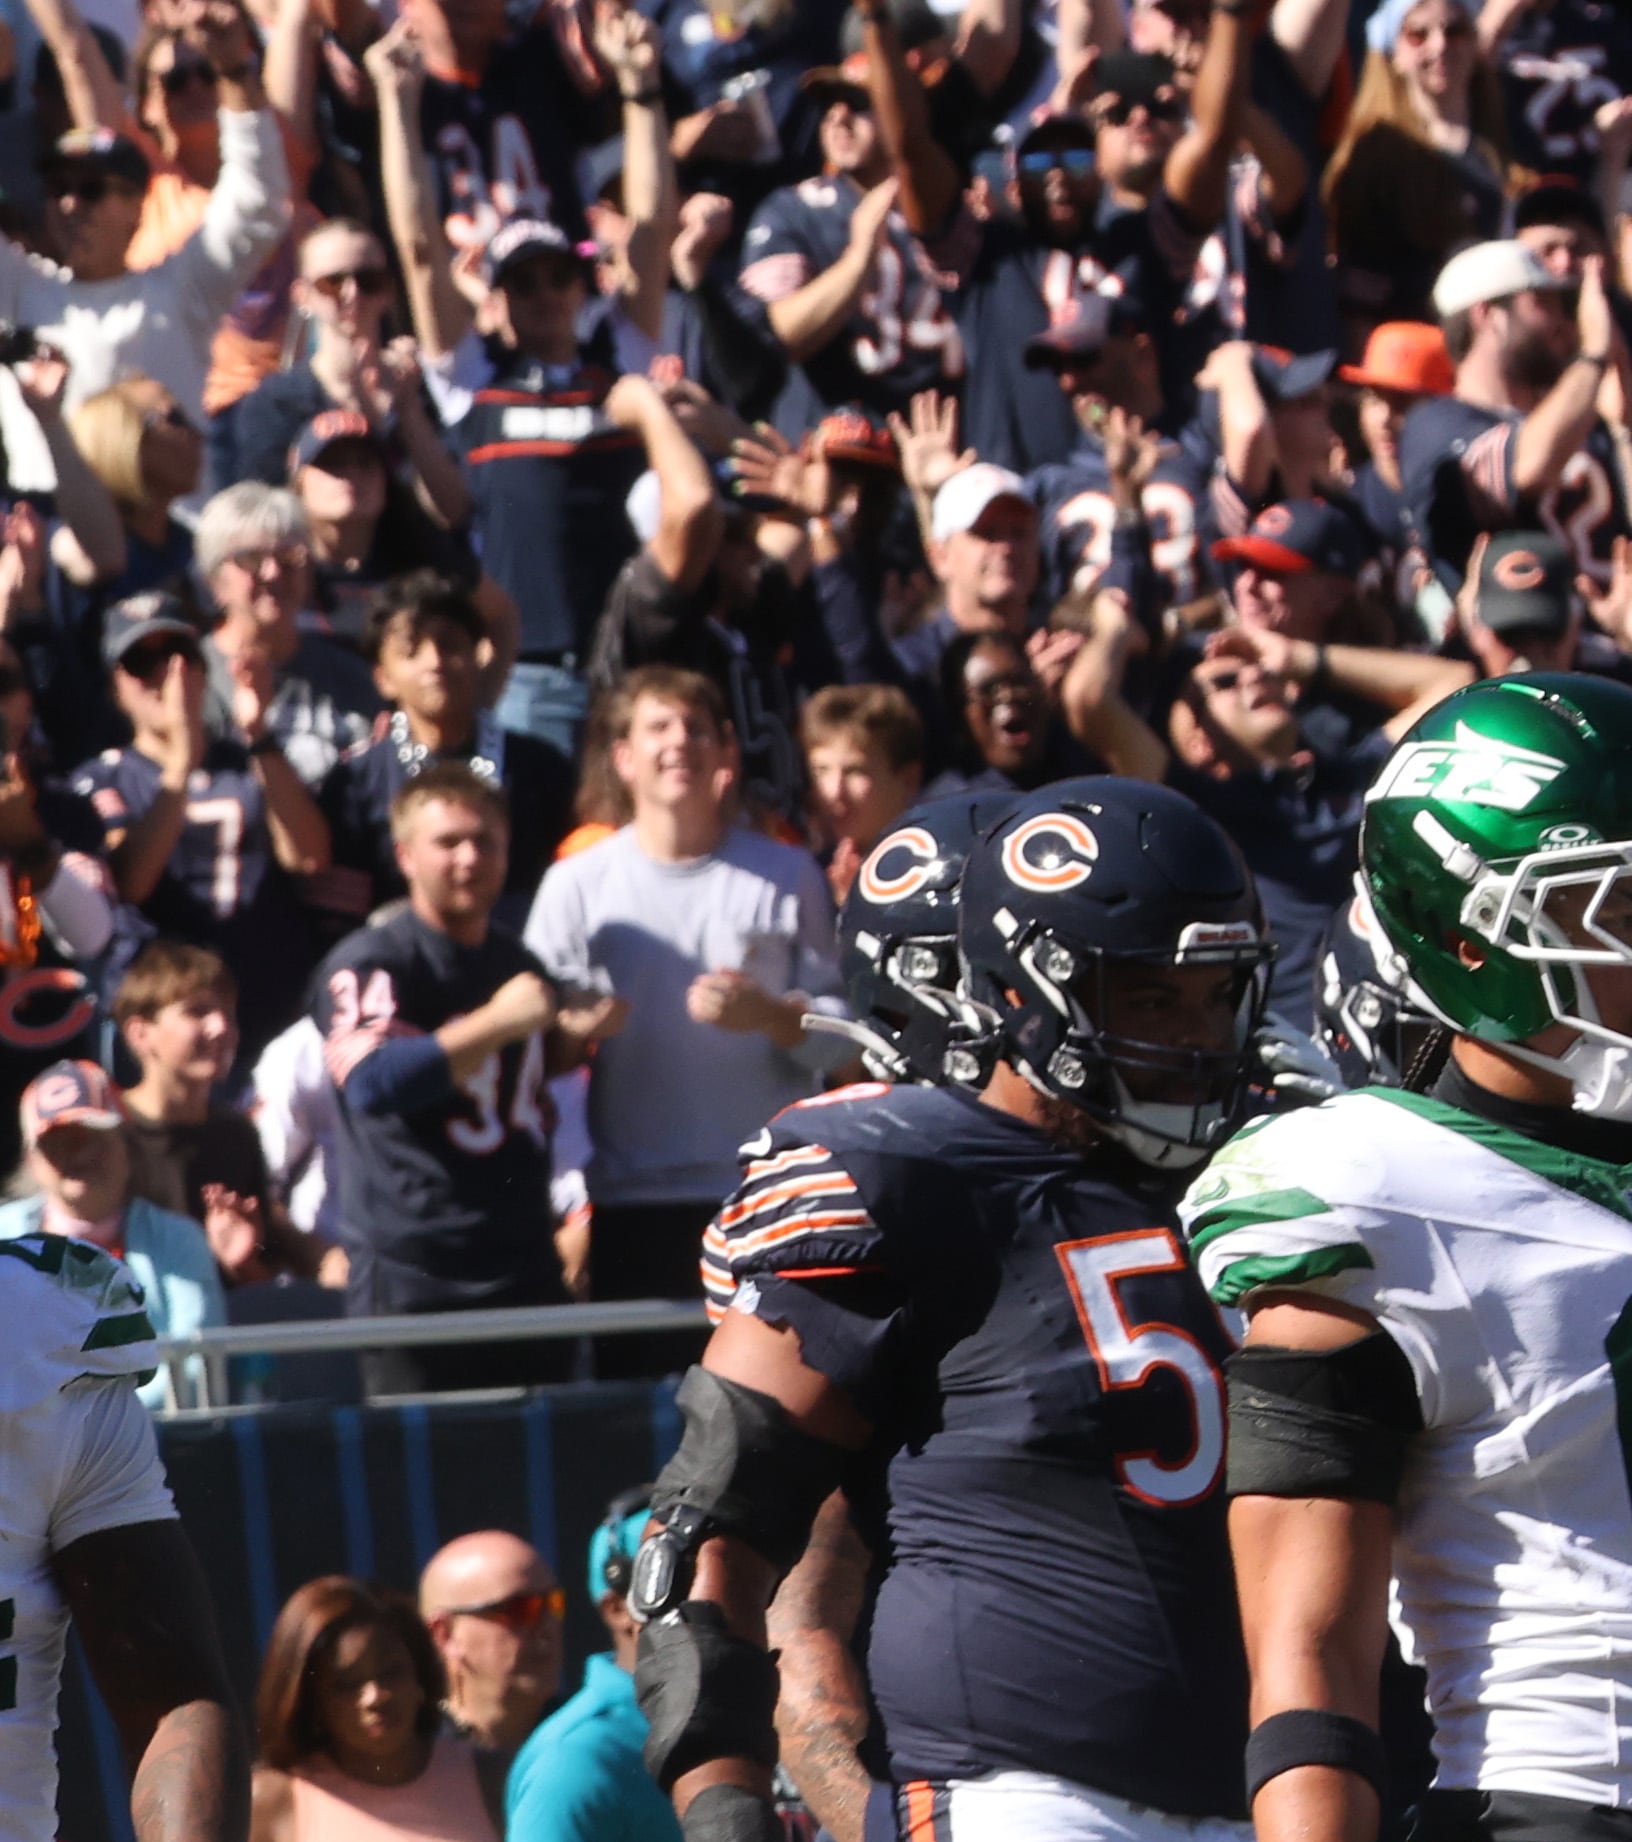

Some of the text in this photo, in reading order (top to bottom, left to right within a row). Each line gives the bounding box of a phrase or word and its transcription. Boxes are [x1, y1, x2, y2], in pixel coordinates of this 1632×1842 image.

[1364, 719, 1569, 812] JETS
[186, 796, 244, 920] 7
[858, 826, 942, 905] C
[1001, 812, 1100, 893] C
[328, 967, 397, 1032] 34
